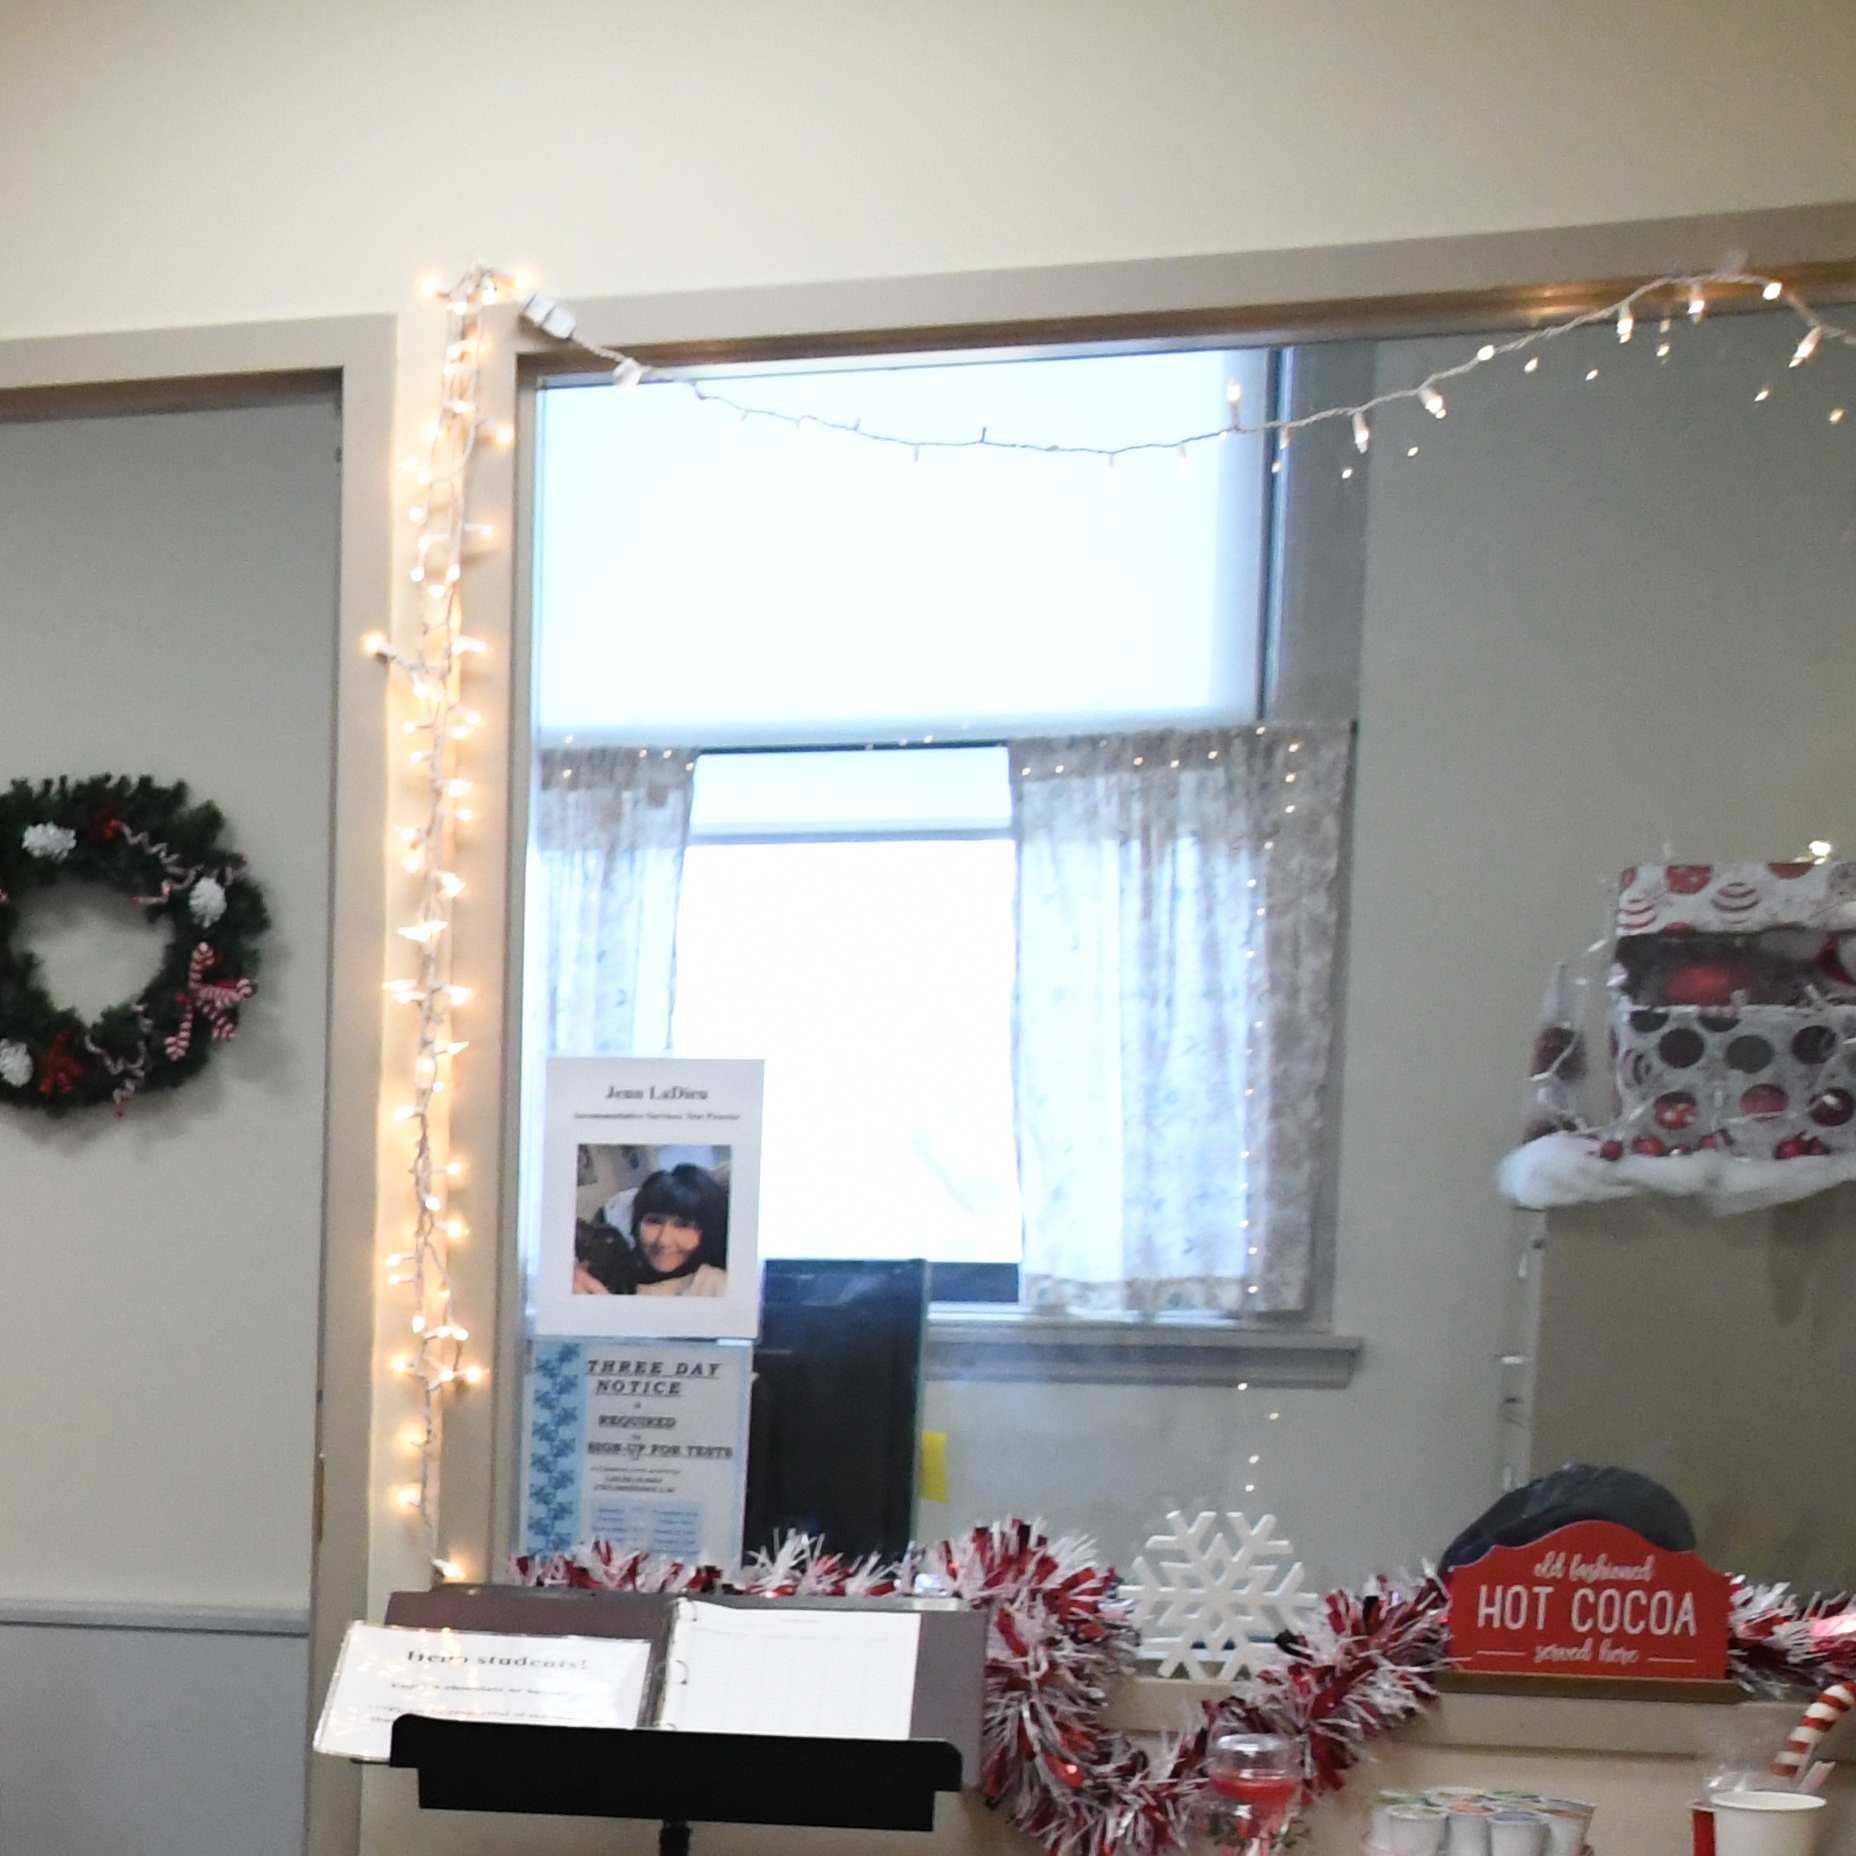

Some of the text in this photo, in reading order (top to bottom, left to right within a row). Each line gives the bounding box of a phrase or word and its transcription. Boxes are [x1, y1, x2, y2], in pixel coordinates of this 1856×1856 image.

[587, 1359, 722, 1376] THREE DAY
[596, 1379, 682, 1395] NOTICE
[598, 1414, 677, 1429] REQUIRED
[650, 1443, 681, 1456] FOR
[1534, 1550, 1656, 1584] old fashioned
[1476, 1584, 1697, 1637] HOT COCOA
[1534, 1637, 1640, 1665] served here
